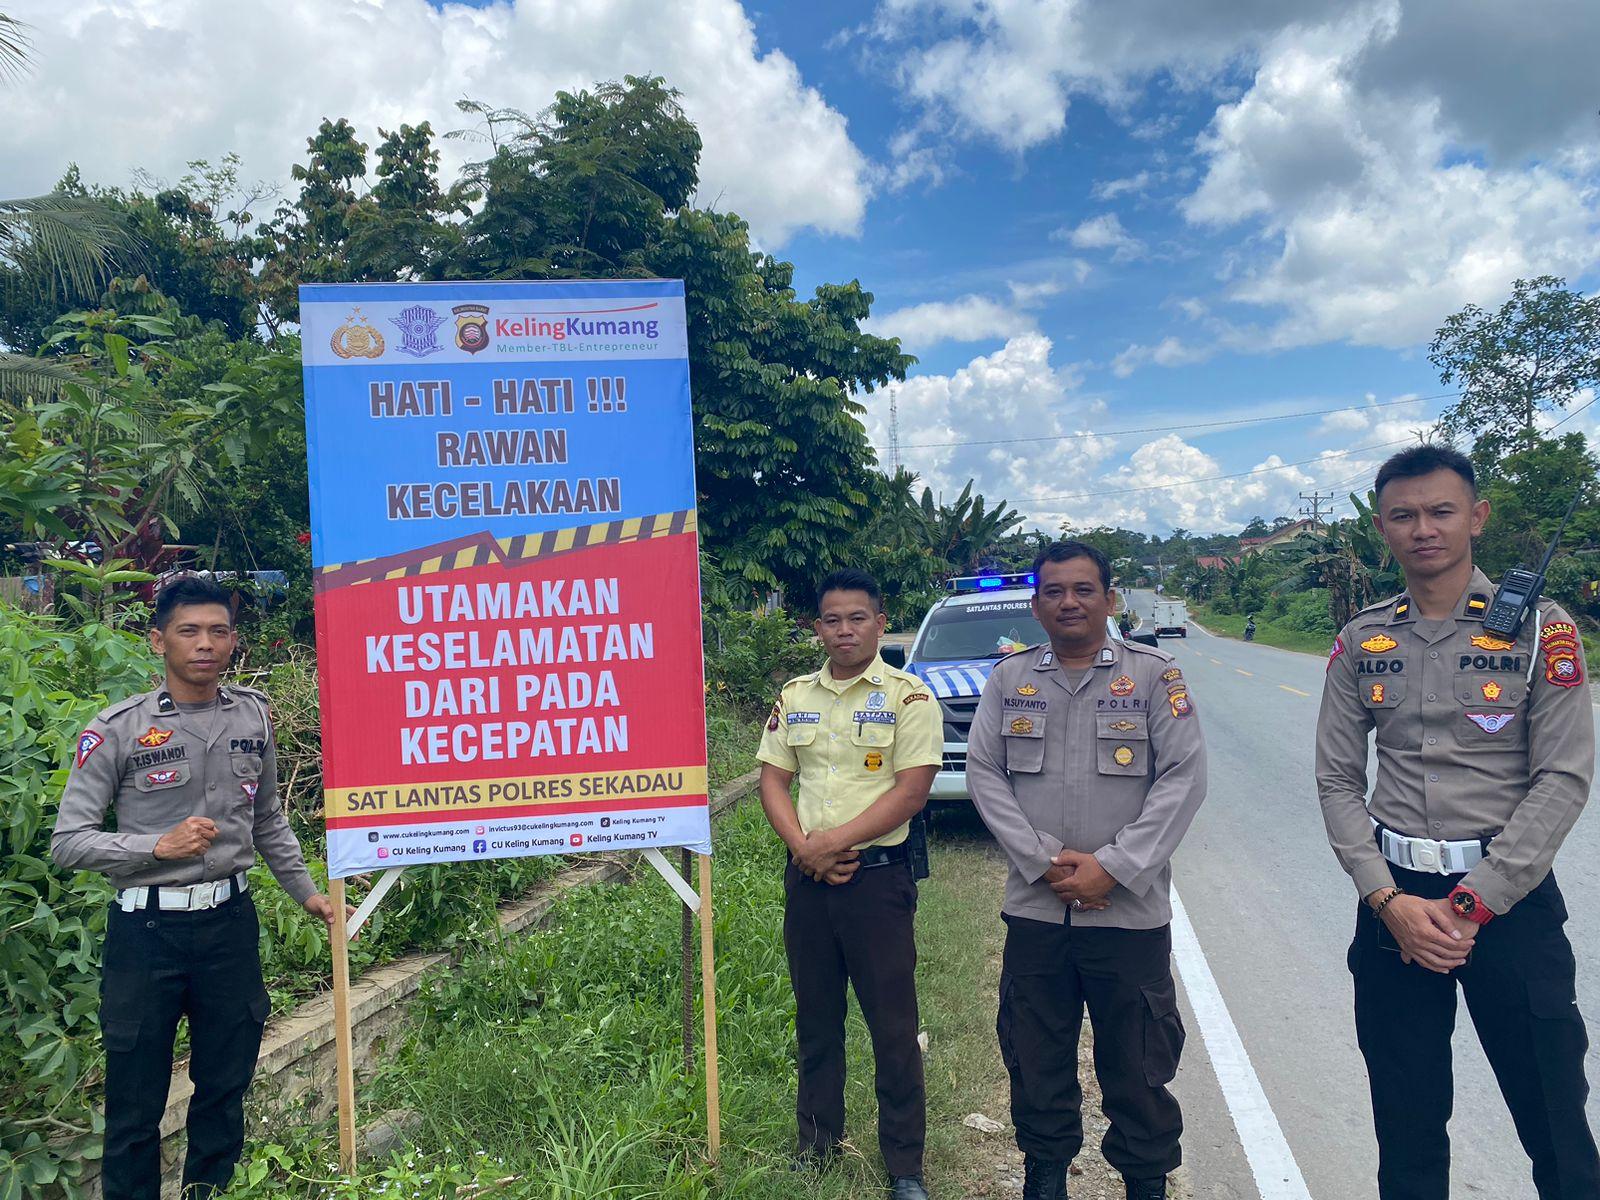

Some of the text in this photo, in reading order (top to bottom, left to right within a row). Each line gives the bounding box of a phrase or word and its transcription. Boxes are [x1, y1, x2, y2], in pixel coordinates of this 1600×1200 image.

[496, 318, 658, 340] KelingKumang
[497, 342, 658, 352] Member-TBL-Entrepreneur
[369, 381, 452, 418] HATI
[493, 378, 574, 414] HATI
[588, 376, 627, 412] !!!
[437, 430, 568, 467] RAWAN
[386, 477, 621, 520] KECELAKAAN
[398, 578, 619, 624] UTAMAKAN
[966, 604, 1002, 612] SATLANTAS
[366, 622, 654, 673] KESELAMATAN
[1358, 660, 1404, 674] ALDO
[1460, 655, 1520, 672] POLRI
[404, 670, 620, 718] DARI PADA
[1098, 700, 1148, 709] POLRI
[400, 715, 629, 765] KECEPATAN
[347, 772, 684, 812] SAT LANTAS POLRES SEKADAU
[383, 828, 470, 839] www.cukelingkumang.com
[505, 839, 530, 848] Keling
[532, 837, 564, 847] Kumang
[587, 834, 612, 844] Keling
[614, 832, 646, 842] Kumang
[406, 846, 431, 856] Keling
[434, 844, 466, 854] Kumang
